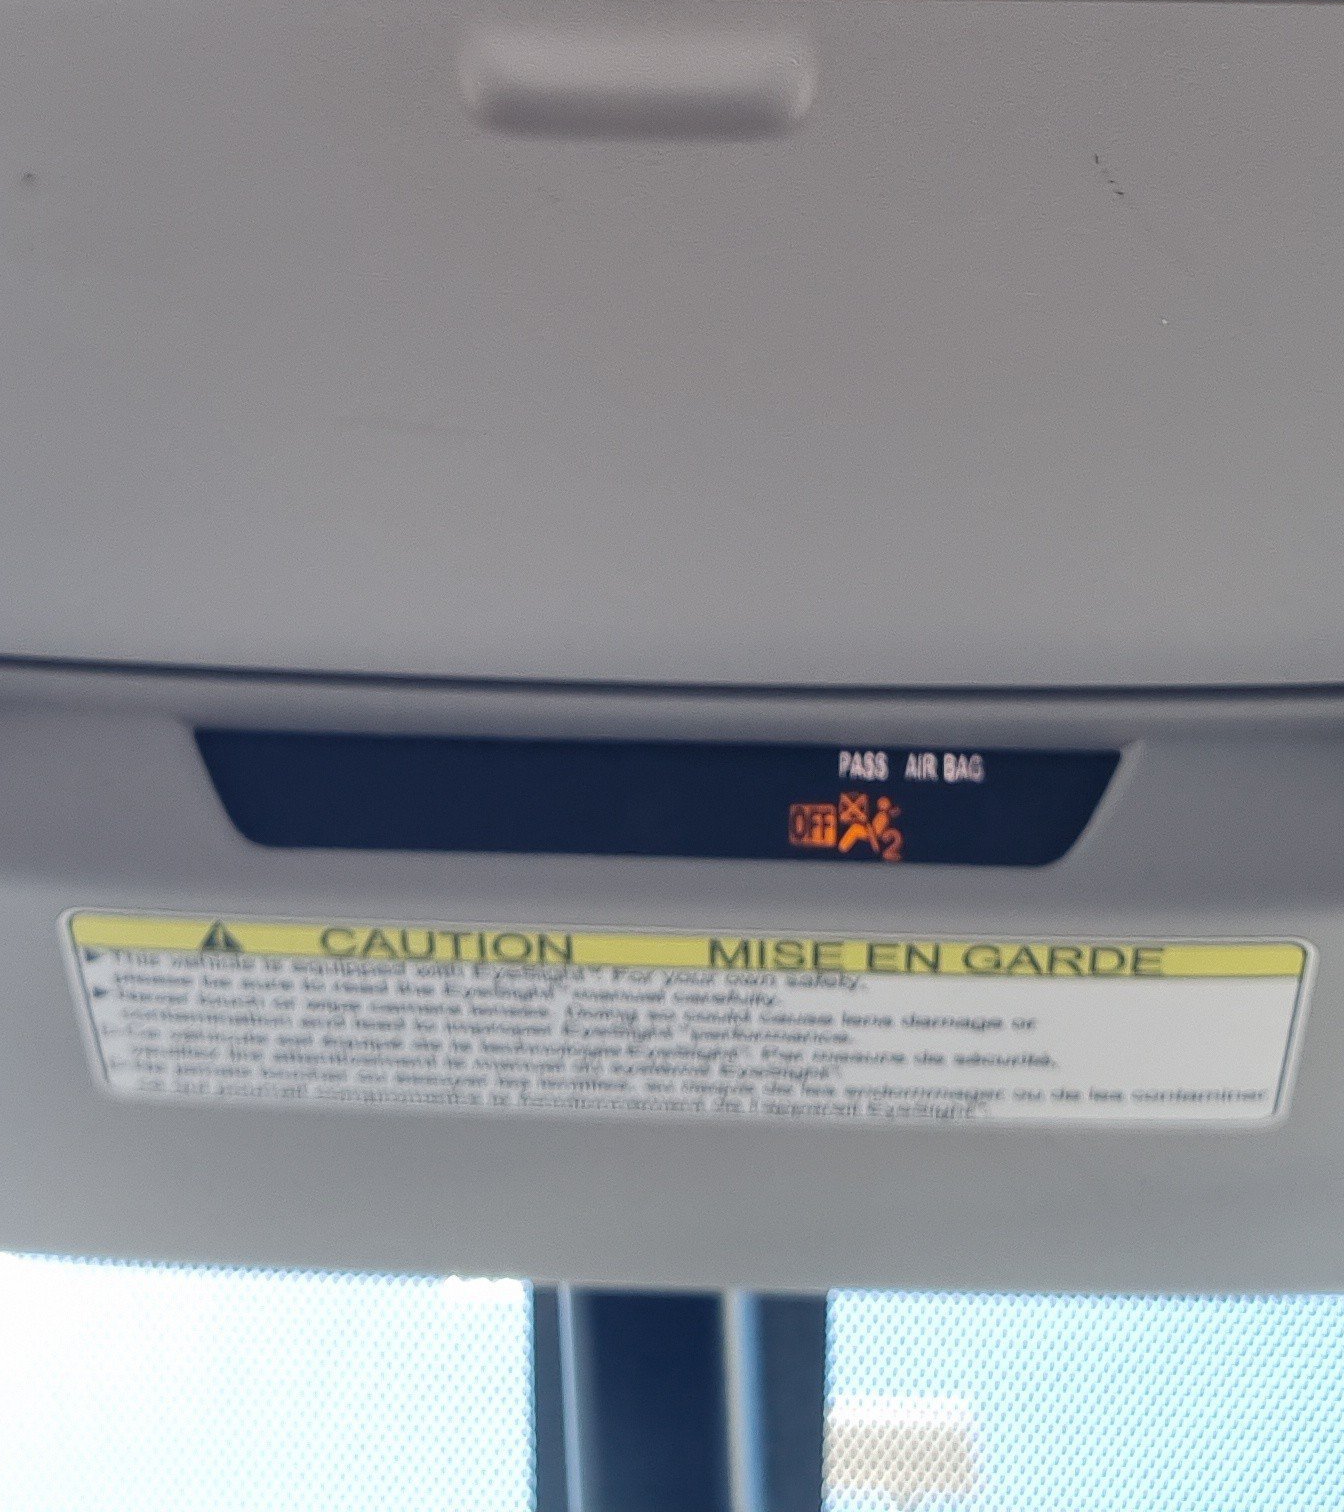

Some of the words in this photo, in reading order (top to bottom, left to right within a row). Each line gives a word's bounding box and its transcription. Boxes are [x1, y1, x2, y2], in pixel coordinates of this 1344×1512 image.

[838, 750, 890, 782] PASS
[905, 752, 939, 782] AIR
[943, 753, 985, 784] BAG
[320, 926, 574, 962] CAUTION
[709, 938, 845, 970] MISE
[867, 942, 941, 973] EN
[962, 944, 1164, 976] GARDE
